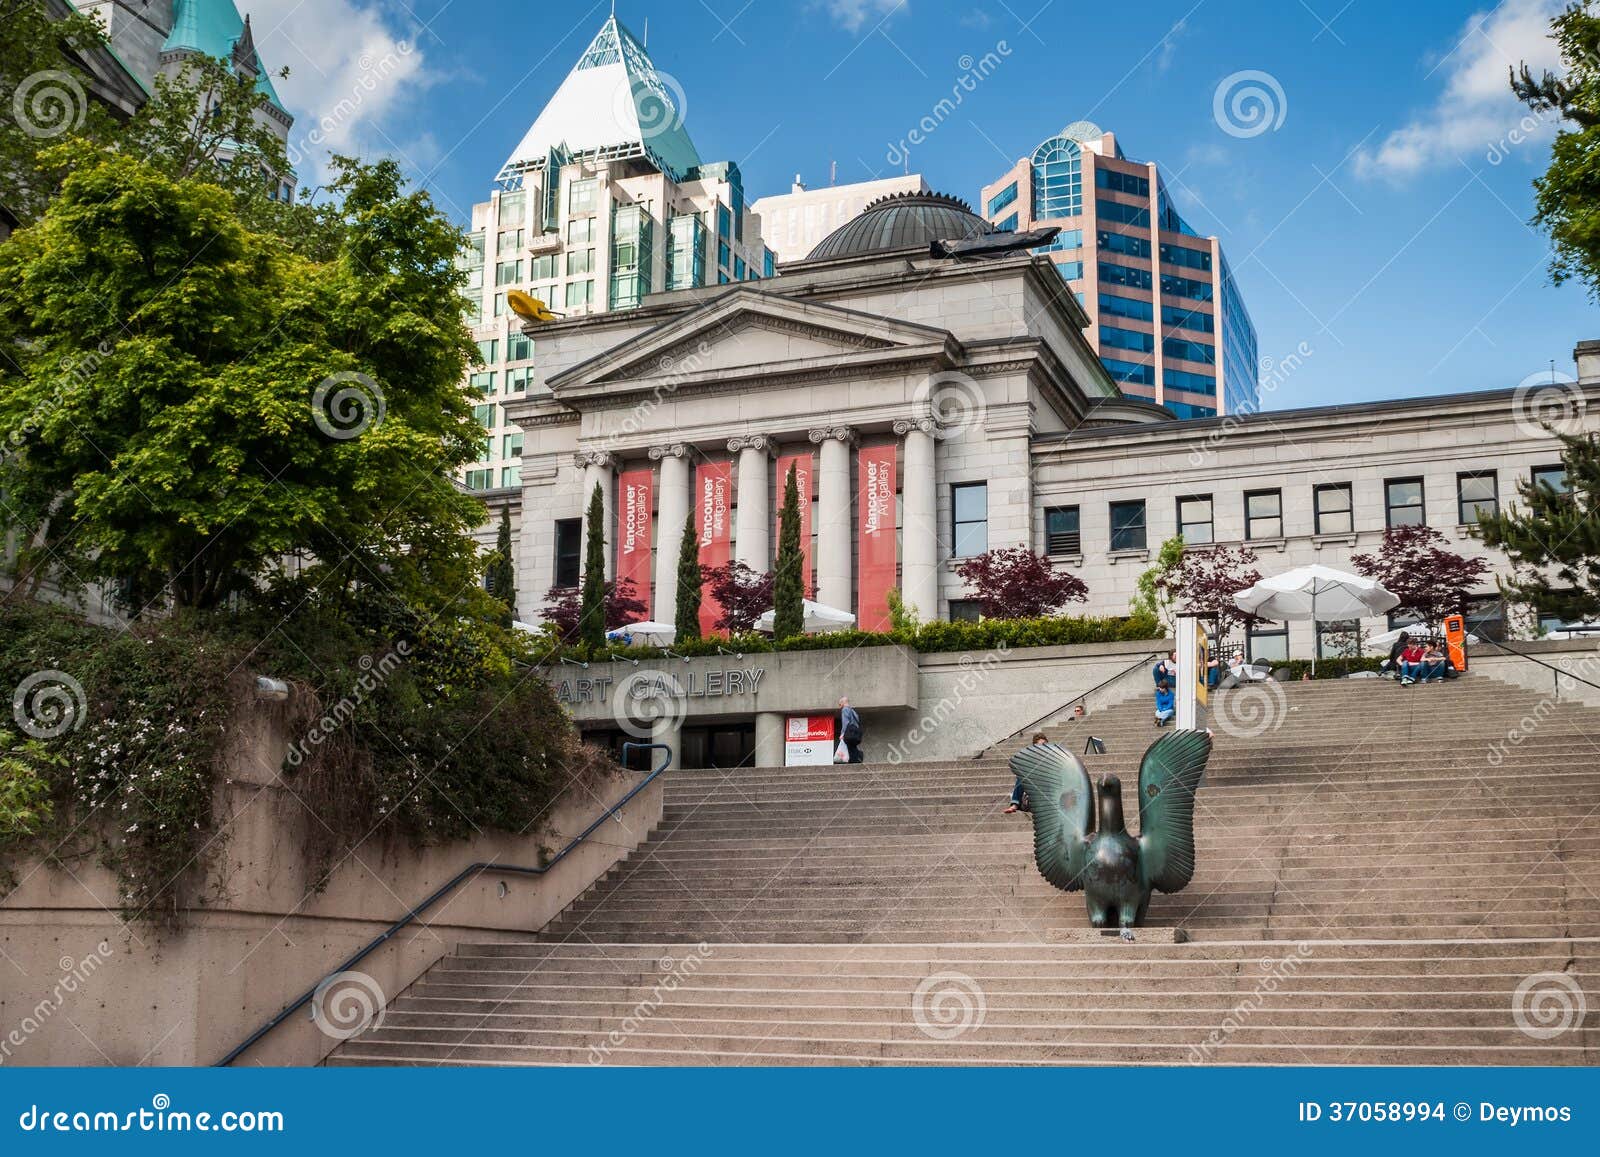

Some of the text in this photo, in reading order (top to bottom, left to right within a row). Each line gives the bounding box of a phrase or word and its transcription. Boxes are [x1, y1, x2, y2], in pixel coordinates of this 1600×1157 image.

[635, 484, 648, 538] Artgallery
[701, 477, 713, 548] Vancouver
[713, 476, 727, 531] Artgallery
[796, 469, 807, 523] tgallery
[865, 461, 877, 534] Vancouver
[878, 460, 891, 516] Artgallery
[624, 485, 636, 554] Vancouver
[557, 667, 764, 703] ART GALLERY
